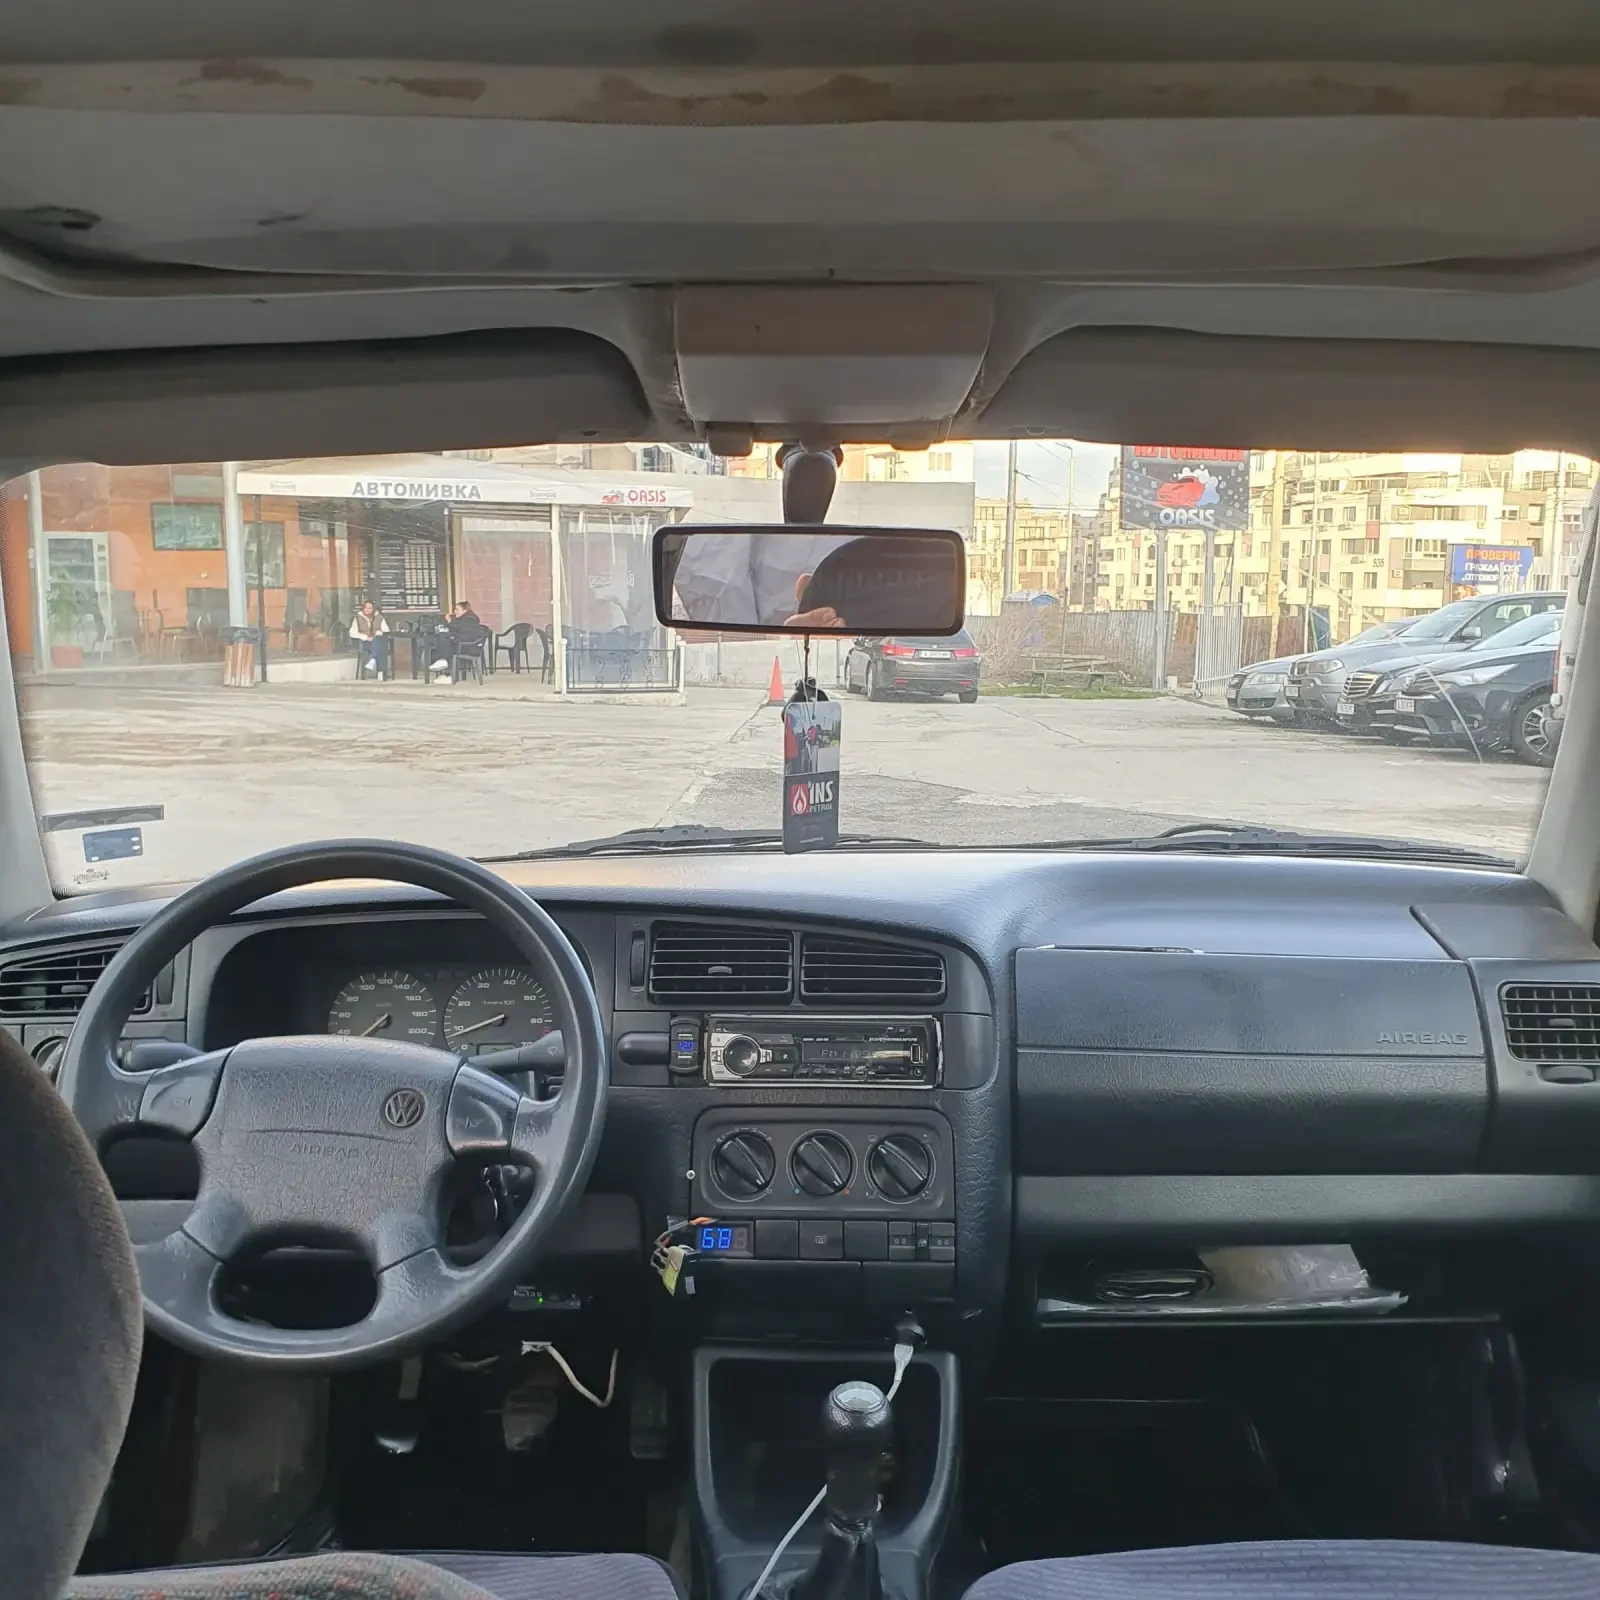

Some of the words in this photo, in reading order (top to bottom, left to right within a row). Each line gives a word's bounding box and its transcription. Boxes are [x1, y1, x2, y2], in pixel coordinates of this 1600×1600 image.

[352, 481, 482, 499] АВТОМИВКА
[628, 489, 667, 503] OASIS
[1159, 508, 1216, 526] OASIS
[1465, 548, 1521, 561] ПРОВЕРИ!
[1376, 1030, 1469, 1046] AIRBAG
